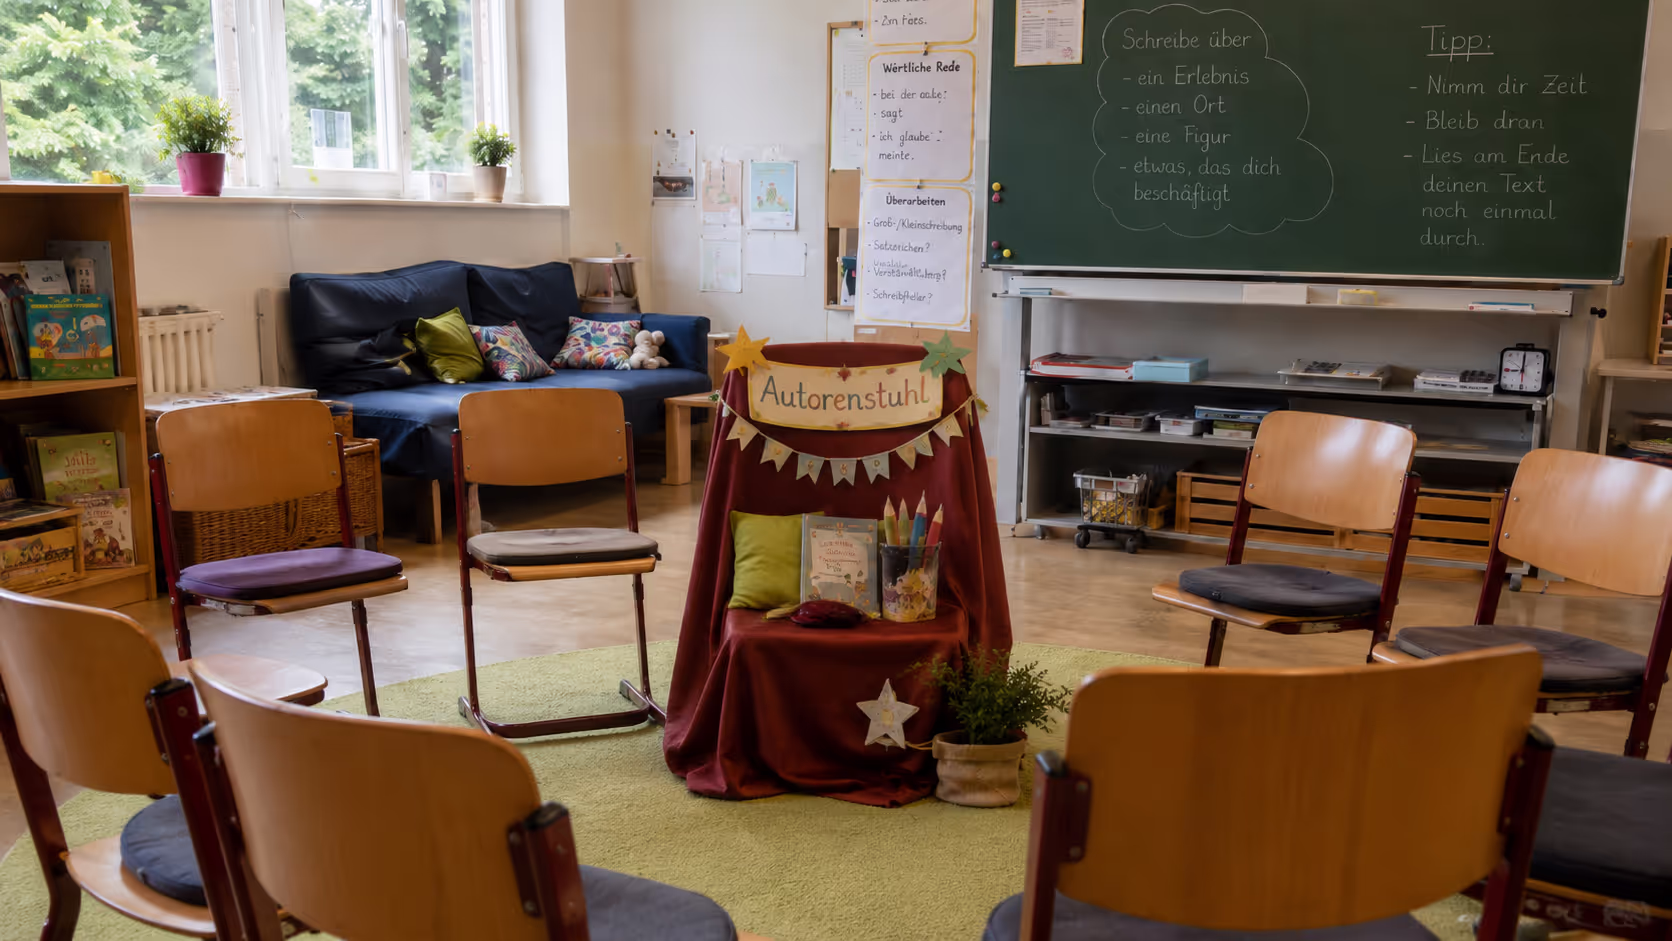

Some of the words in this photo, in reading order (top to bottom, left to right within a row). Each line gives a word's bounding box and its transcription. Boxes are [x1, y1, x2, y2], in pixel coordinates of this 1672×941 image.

[1122, 27, 1200, 50] Schreibe
[1209, 29, 1252, 48] über
[1420, 24, 1494, 63] Tipp:
[936, 60, 961, 73] Rede
[1137, 69, 1165, 86] ein
[1174, 64, 1250, 85] Erlebnis
[880, 88, 895, 100] bei
[900, 88, 917, 100] der
[1427, 74, 1486, 95] Nimm
[1497, 74, 1529, 95] dir
[1541, 73, 1588, 95] Zeit
[1135, 99, 1182, 115] einen
[1193, 94, 1227, 114] Ort
[880, 107, 903, 124] sagt
[1425, 109, 1479, 130] Bleib
[1493, 109, 1545, 130] dran
[879, 130, 893, 141] ich
[1135, 128, 1171, 144] eine
[1184, 124, 1232, 153] Figur
[1422, 143, 1463, 164] Lies
[1473, 150, 1508, 164] am
[1517, 142, 1570, 164] Ende
[1133, 156, 1192, 177] etwas,
[1198, 156, 1231, 176] das
[1242, 156, 1282, 176] dich
[1422, 174, 1489, 193] deinen
[1499, 173, 1547, 193] Text
[885, 192, 946, 207] Überarbeiten
[1134, 181, 1231, 211] beschäftigt
[1421, 200, 1468, 218] noch
[1483, 199, 1557, 220] einmal
[1419, 226, 1485, 246] durch.
[760, 374, 931, 411] Autorenstuhl
